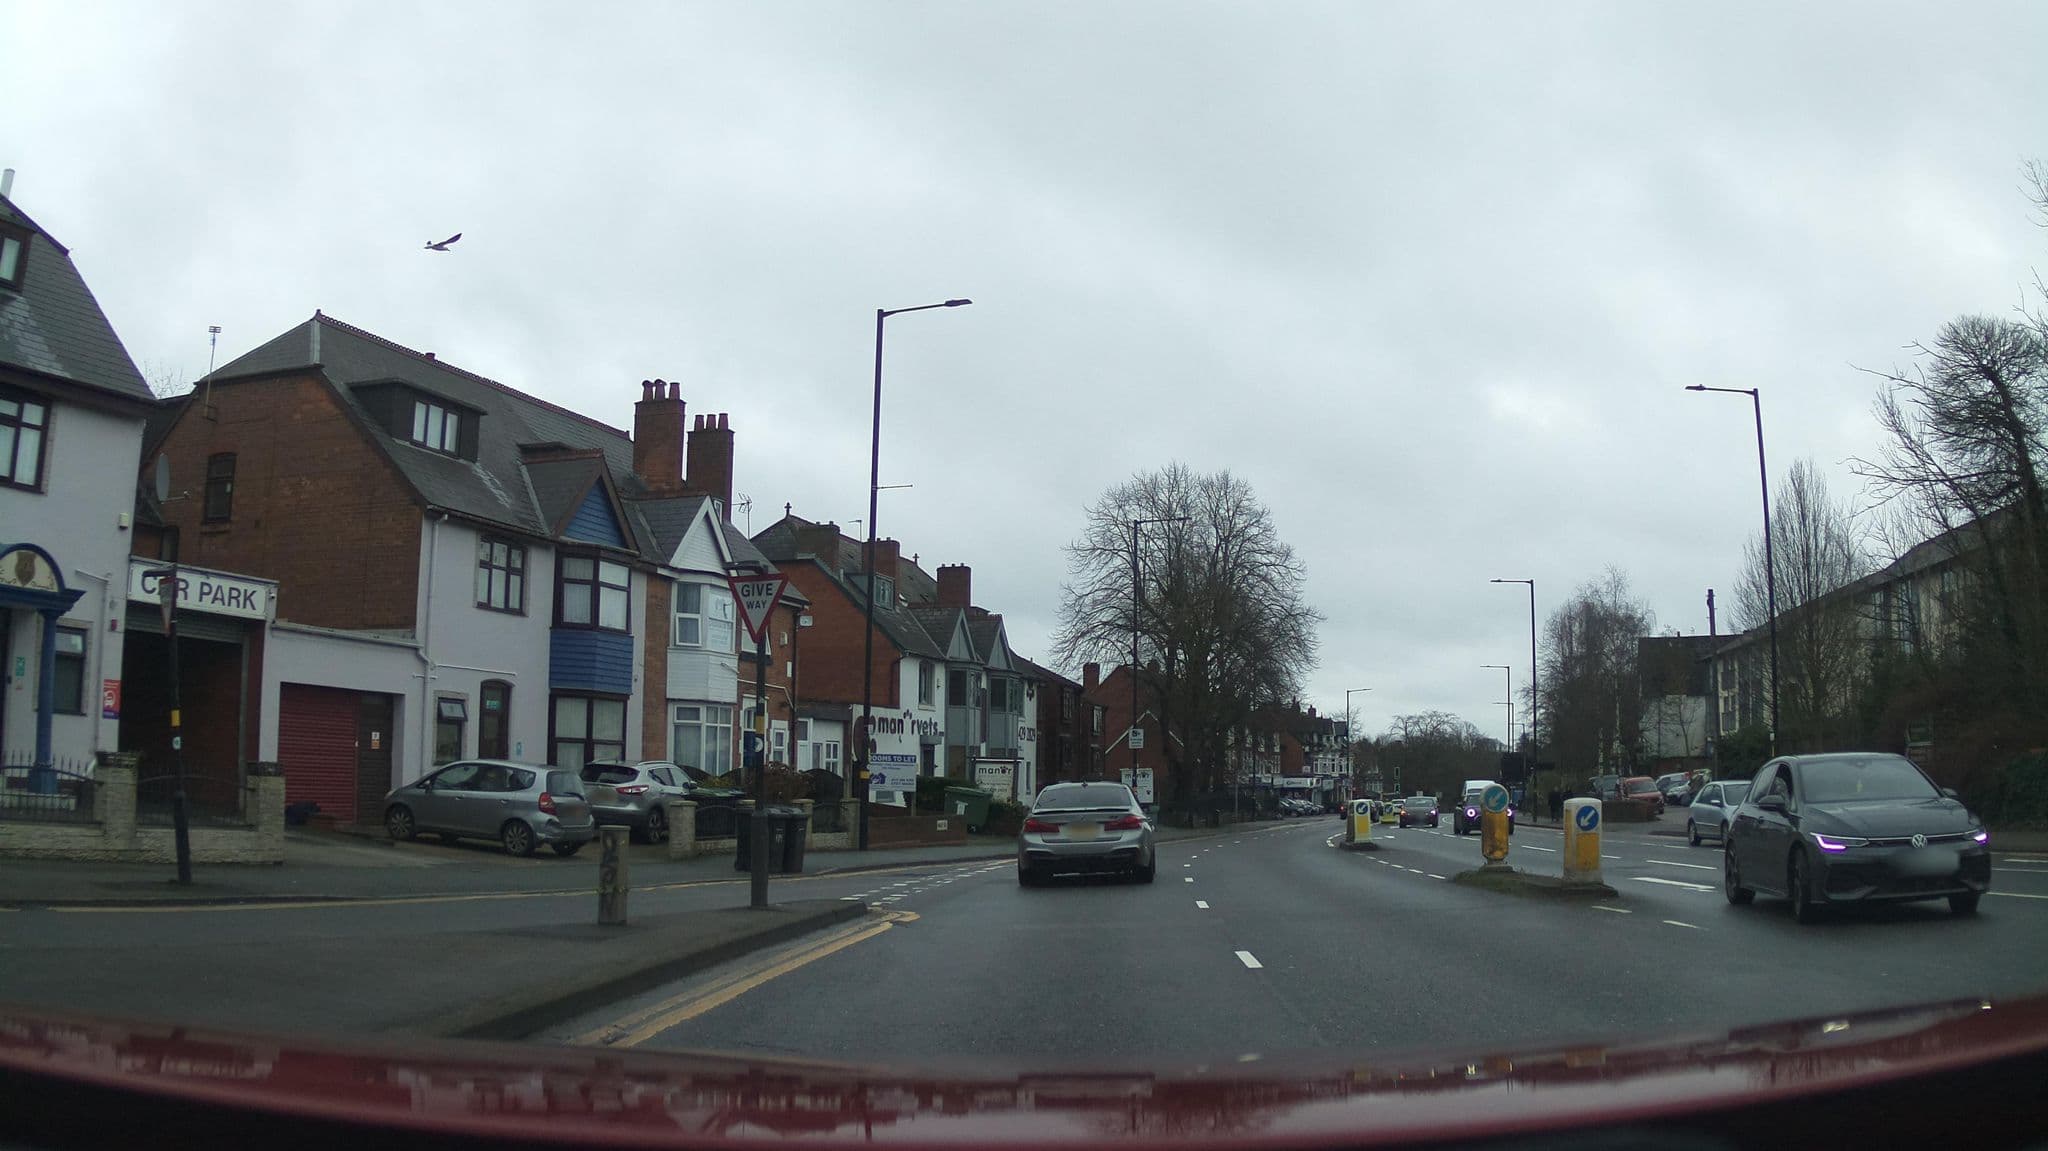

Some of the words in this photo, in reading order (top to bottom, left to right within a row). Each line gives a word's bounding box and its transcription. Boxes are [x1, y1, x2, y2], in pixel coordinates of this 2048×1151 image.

[141, 574, 190, 601] CR
[199, 581, 257, 610] PARK
[741, 583, 773, 597] GIVE
[746, 600, 767, 609] WAY
